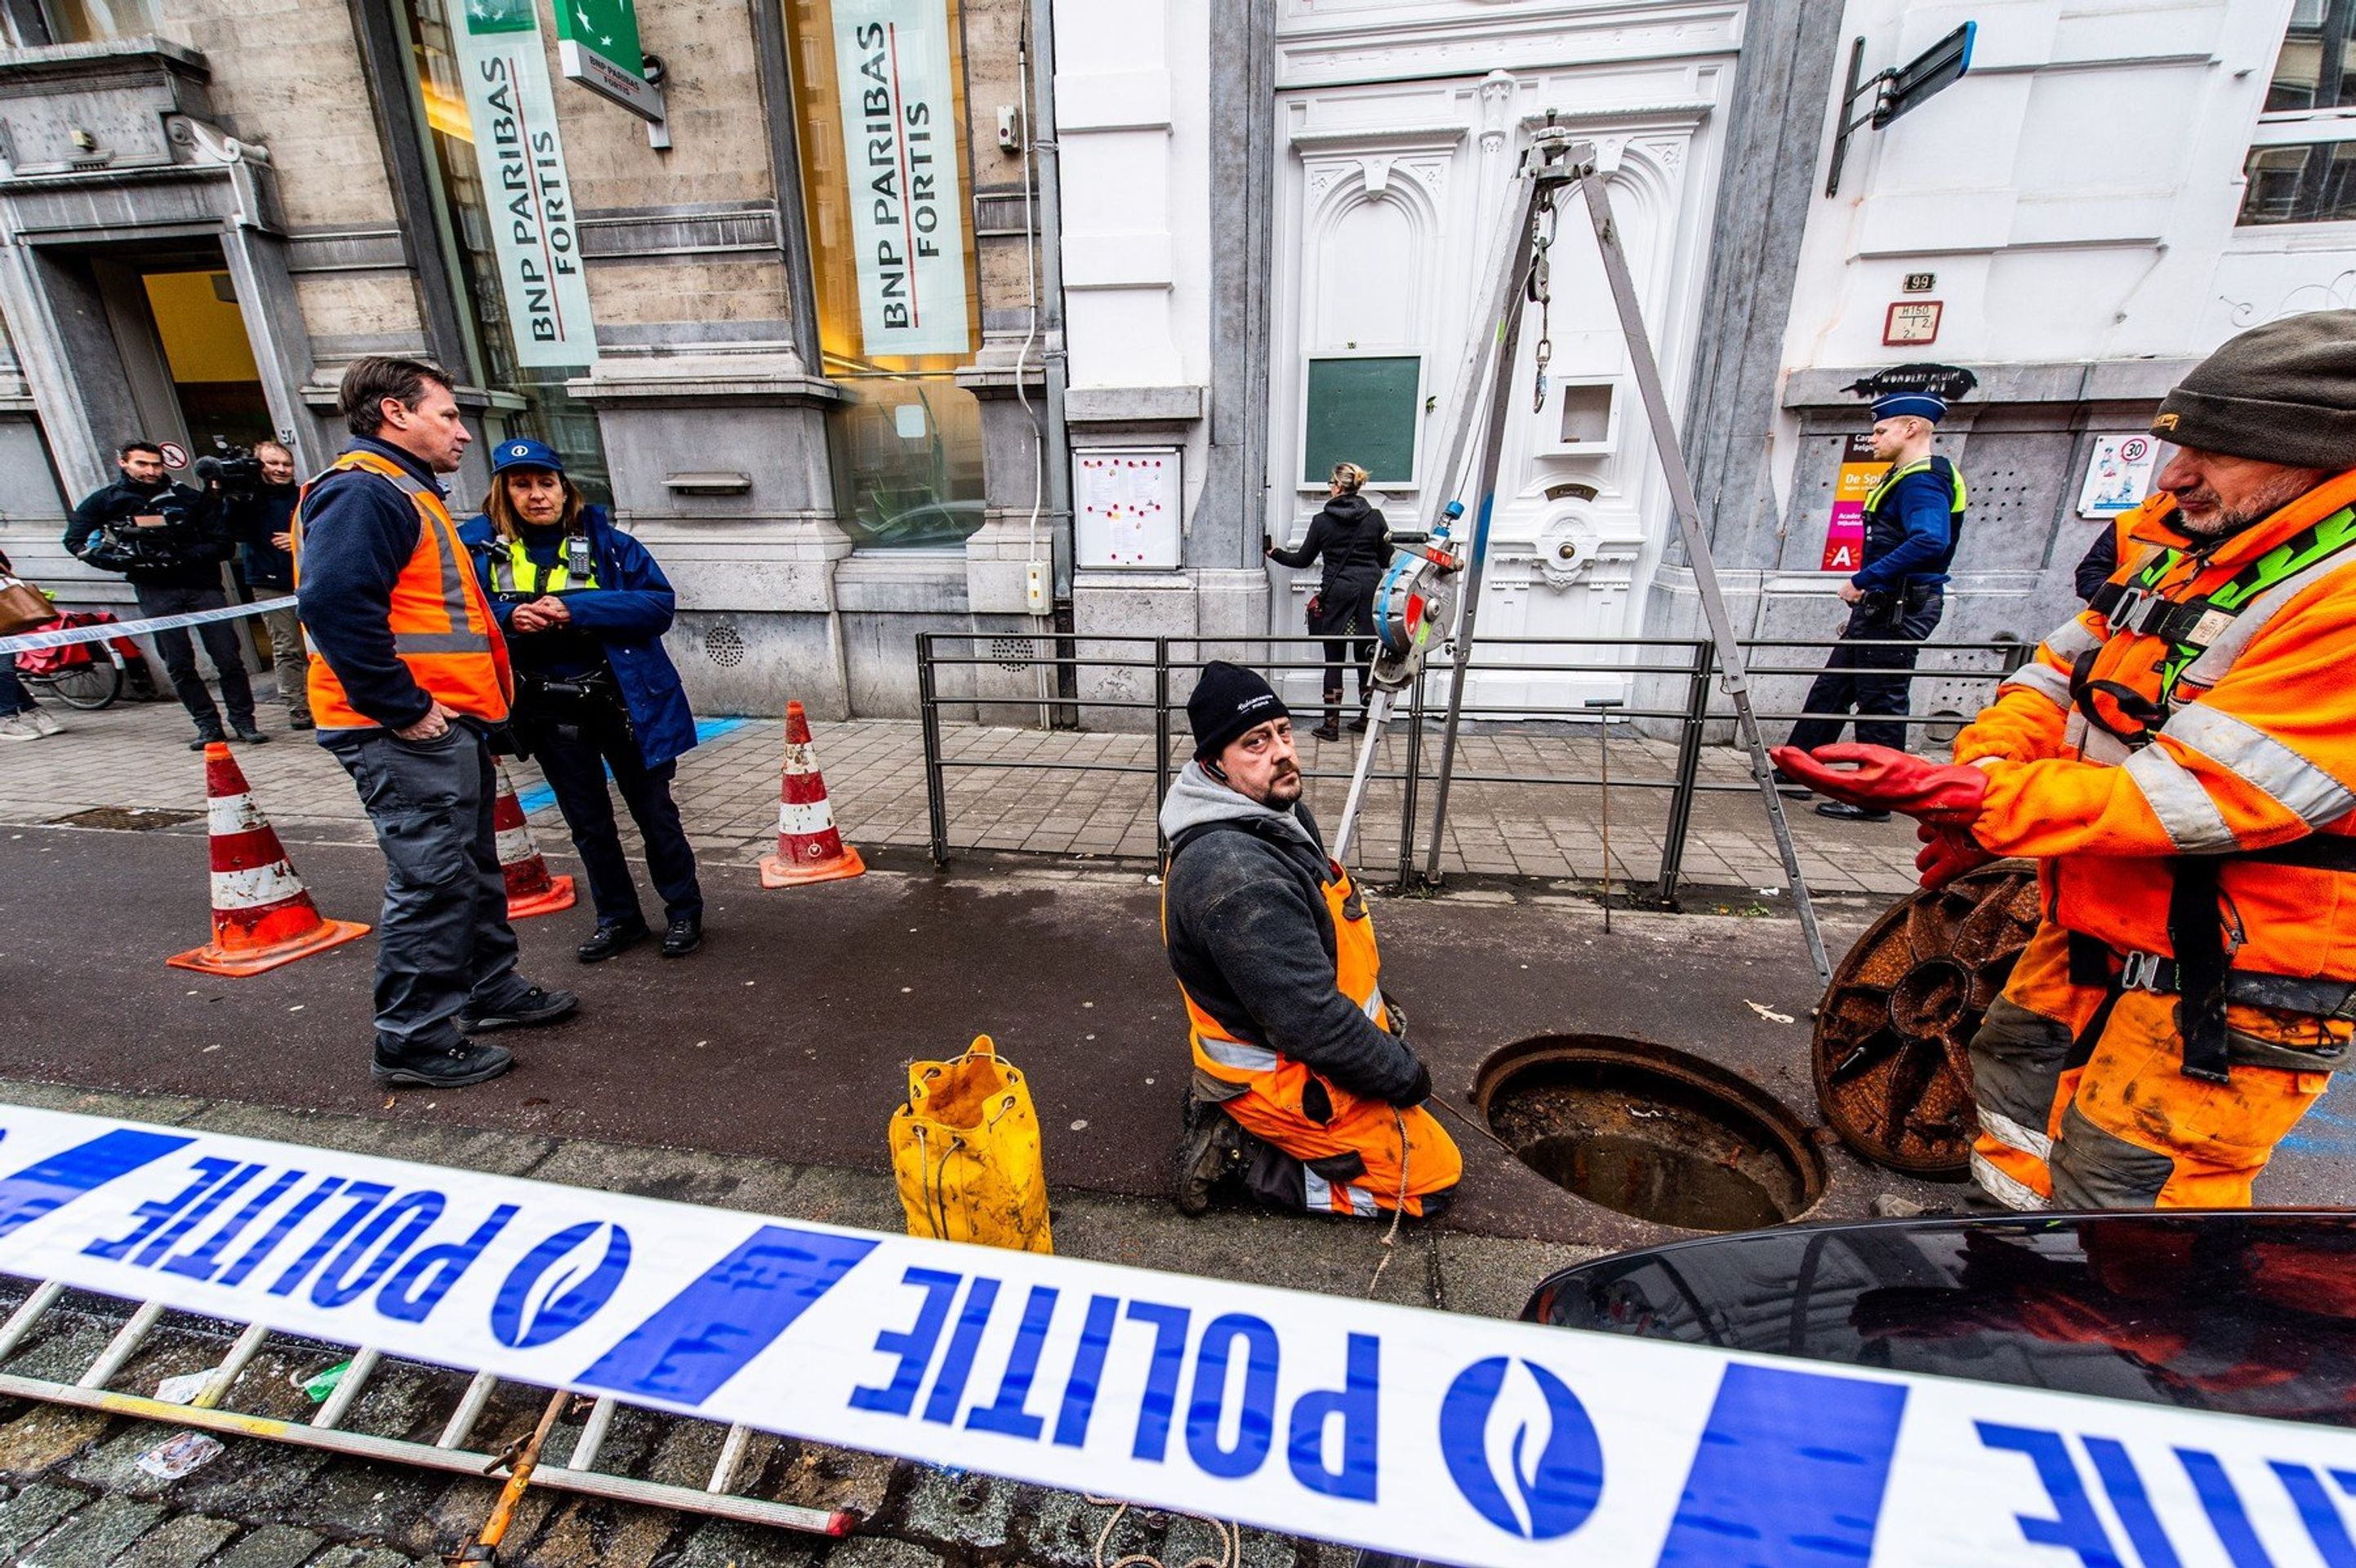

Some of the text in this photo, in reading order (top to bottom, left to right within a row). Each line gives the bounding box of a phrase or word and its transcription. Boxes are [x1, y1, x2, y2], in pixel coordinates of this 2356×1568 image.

[482, 55, 557, 343] BNP PARIBAS
[532, 130, 577, 276] FORTIS
[857, 21, 909, 329] BNP PARIBAS
[906, 100, 940, 258] FORTIS
[1912, 276, 1929, 288] 99
[280, 427, 295, 443] 97
[1846, 474, 1860, 483] De
[2127, 443, 2143, 457] 30
[79, 1156, 523, 1325] POLITIE
[848, 1267, 1380, 1504] POLITIE
